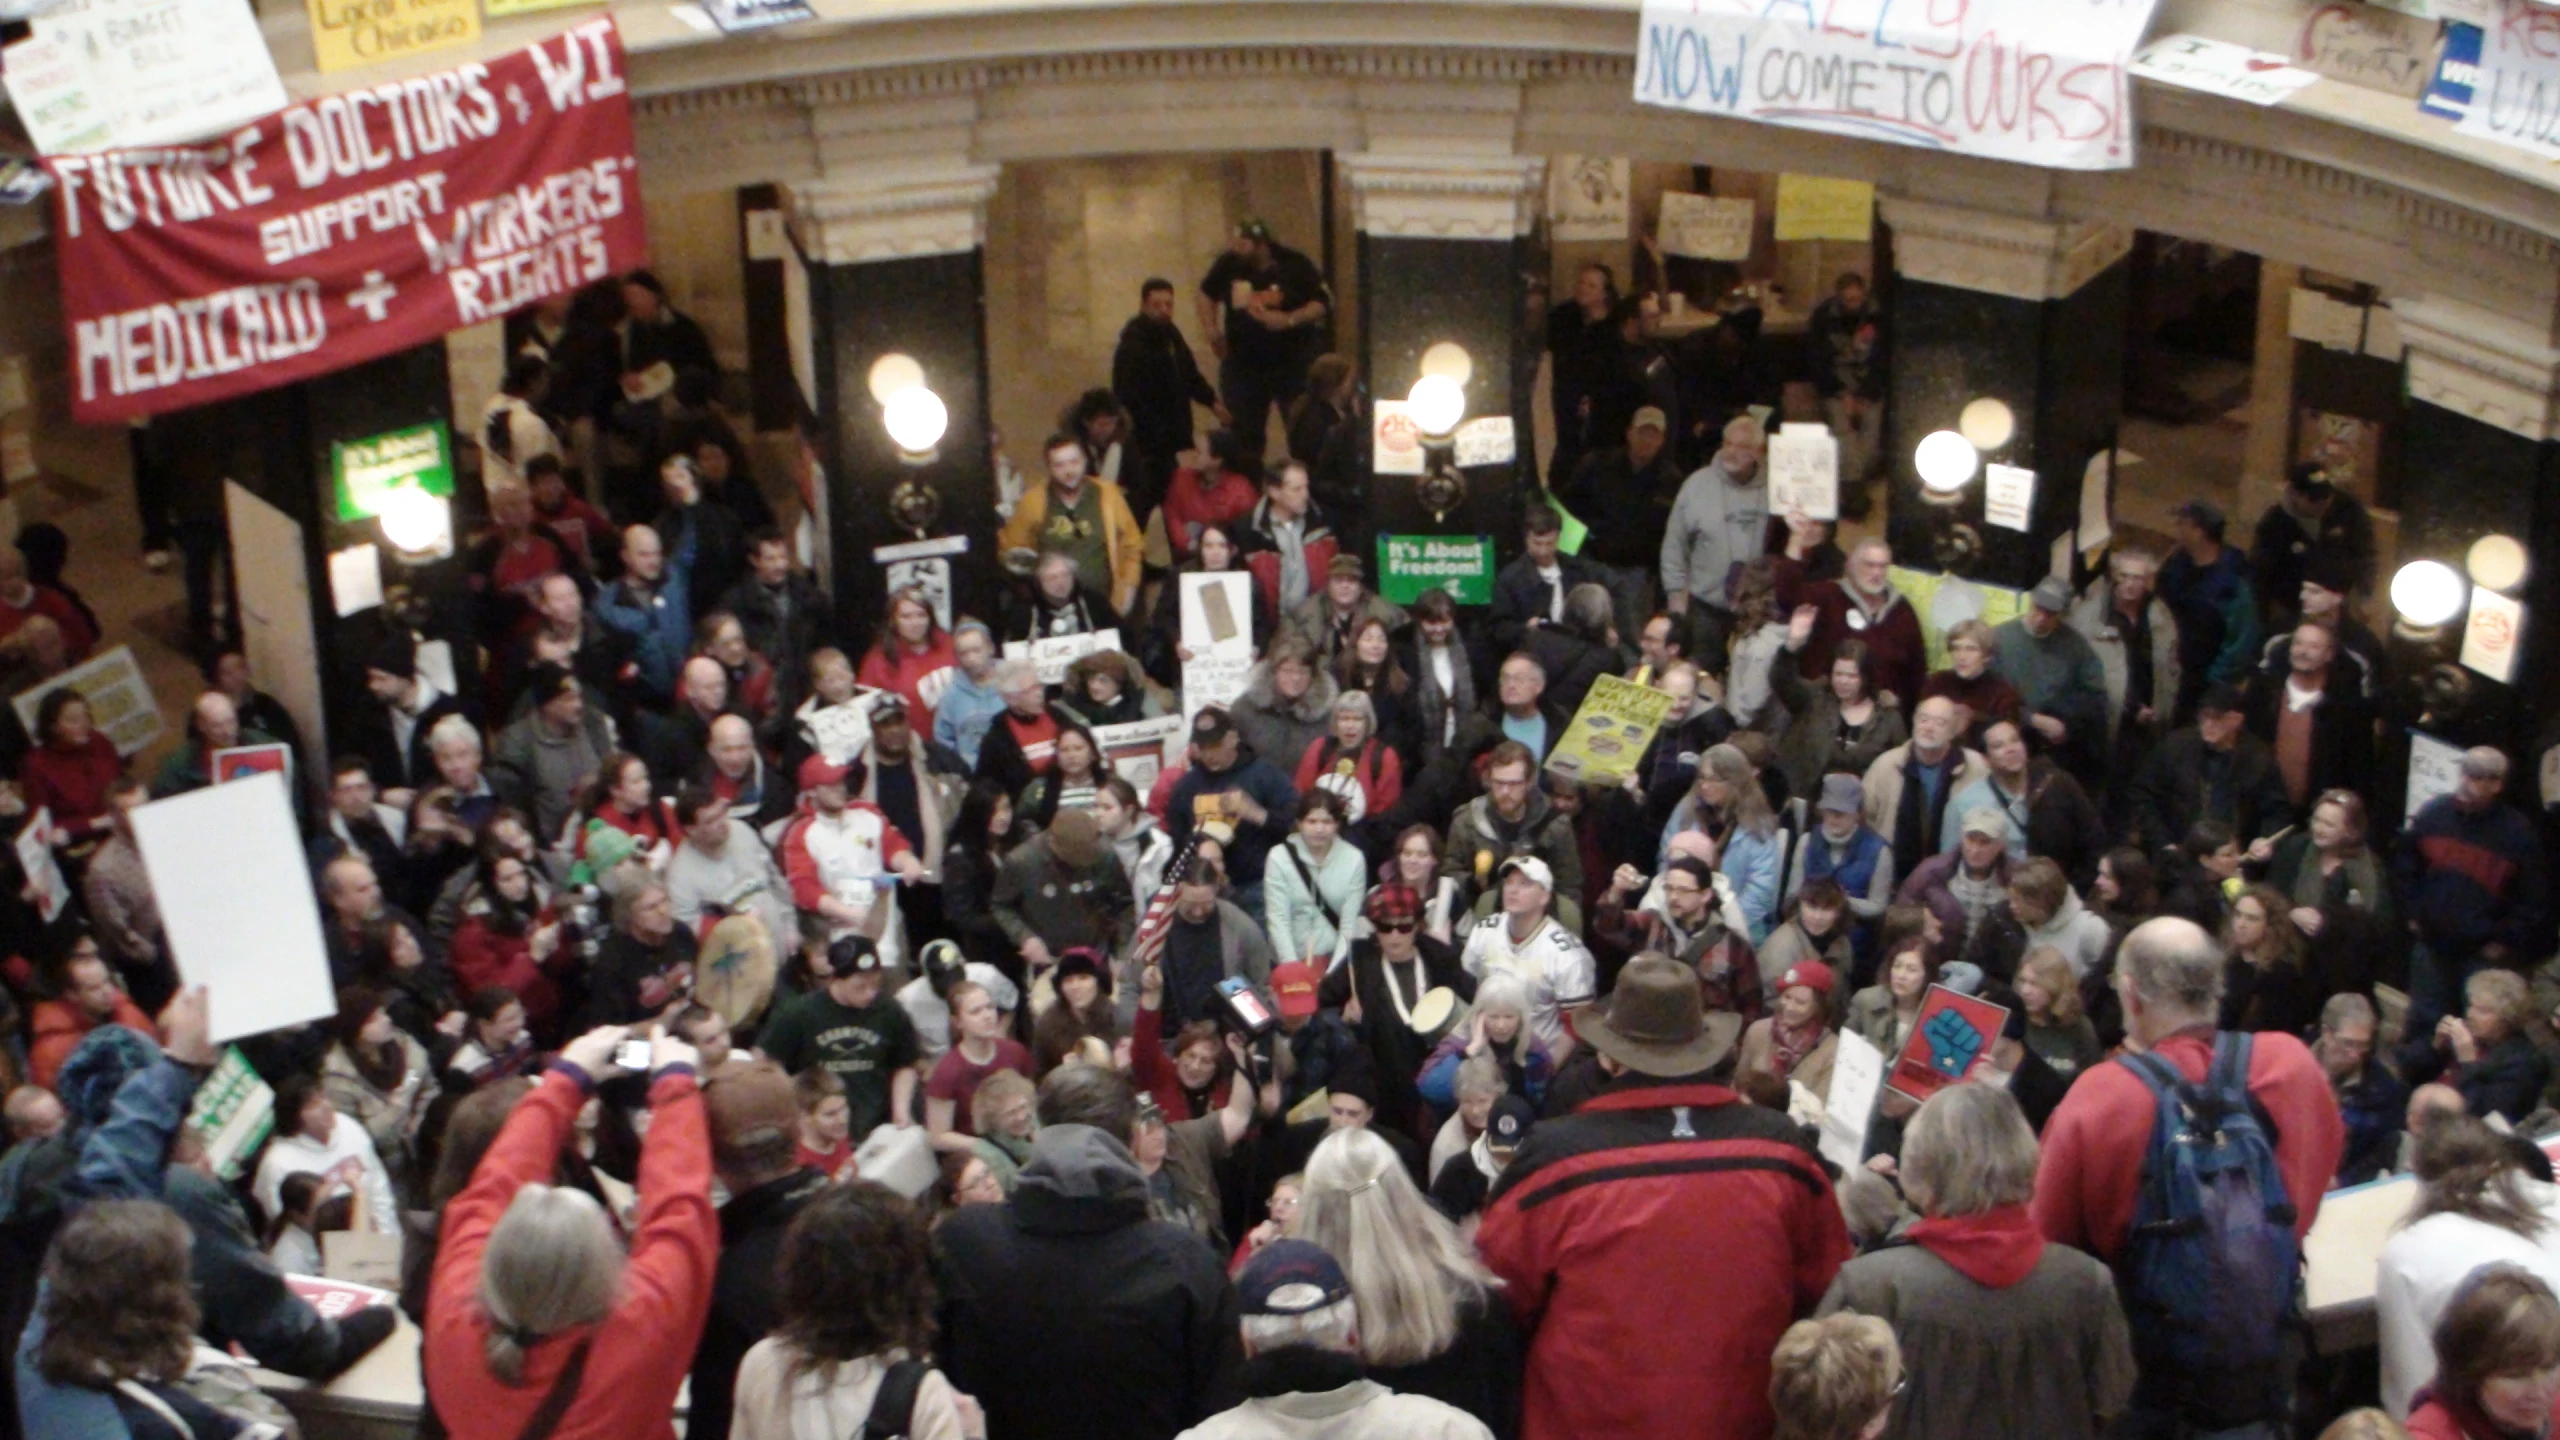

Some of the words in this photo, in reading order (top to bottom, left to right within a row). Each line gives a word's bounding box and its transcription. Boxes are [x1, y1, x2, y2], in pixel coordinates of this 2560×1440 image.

[2499, 0, 2560, 58] RE
[53, 127, 274, 238] FUTURE
[282, 62, 501, 189] DOCTORS
[528, 18, 626, 113] WI
[1643, 24, 1747, 110] NOW
[1757, 47, 1878, 117] COME
[1884, 62, 1953, 126] TO
[1962, 30, 2122, 157] OURS!
[2488, 68, 2560, 146] UN
[260, 171, 448, 266] SUPPORT
[448, 224, 610, 324] RIGHTS
[75, 277, 327, 402] MEDICAID
[1388, 542, 1420, 558] It's
[1425, 542, 1483, 558] About
[1389, 559, 1484, 576] Freedom!
